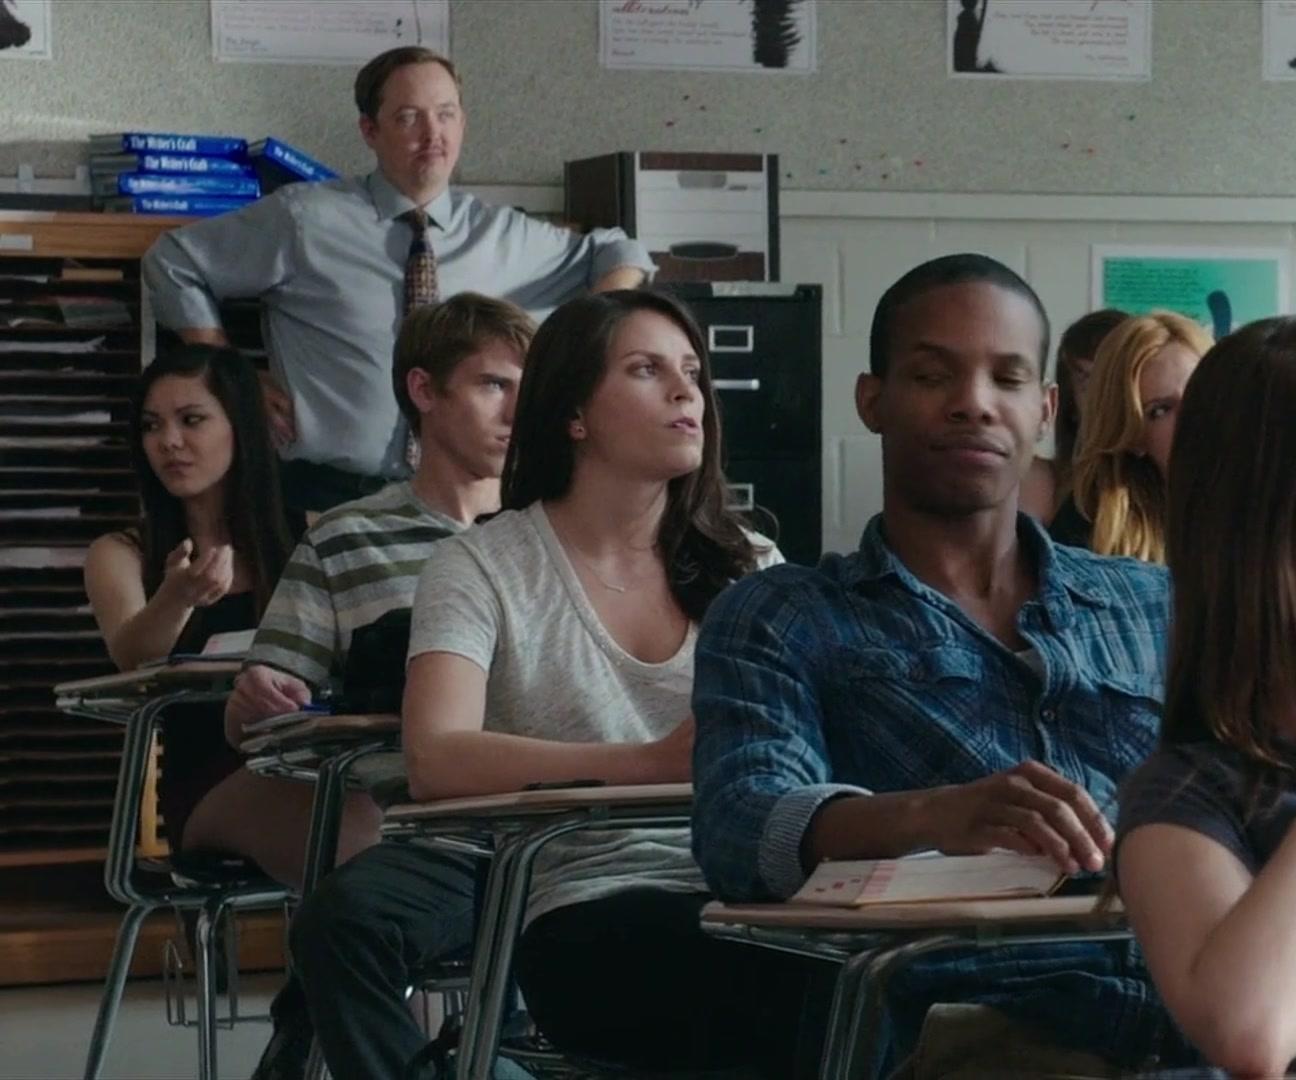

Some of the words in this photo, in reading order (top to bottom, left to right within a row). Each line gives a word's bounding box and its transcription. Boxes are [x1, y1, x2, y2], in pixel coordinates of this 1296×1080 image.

[130, 135, 145, 149] The
[147, 136, 176, 151] Writer's
[176, 138, 197, 151] Craft
[144, 155, 160, 170] The
[160, 156, 188, 171] Writer's
[188, 157, 208, 172] Craft
